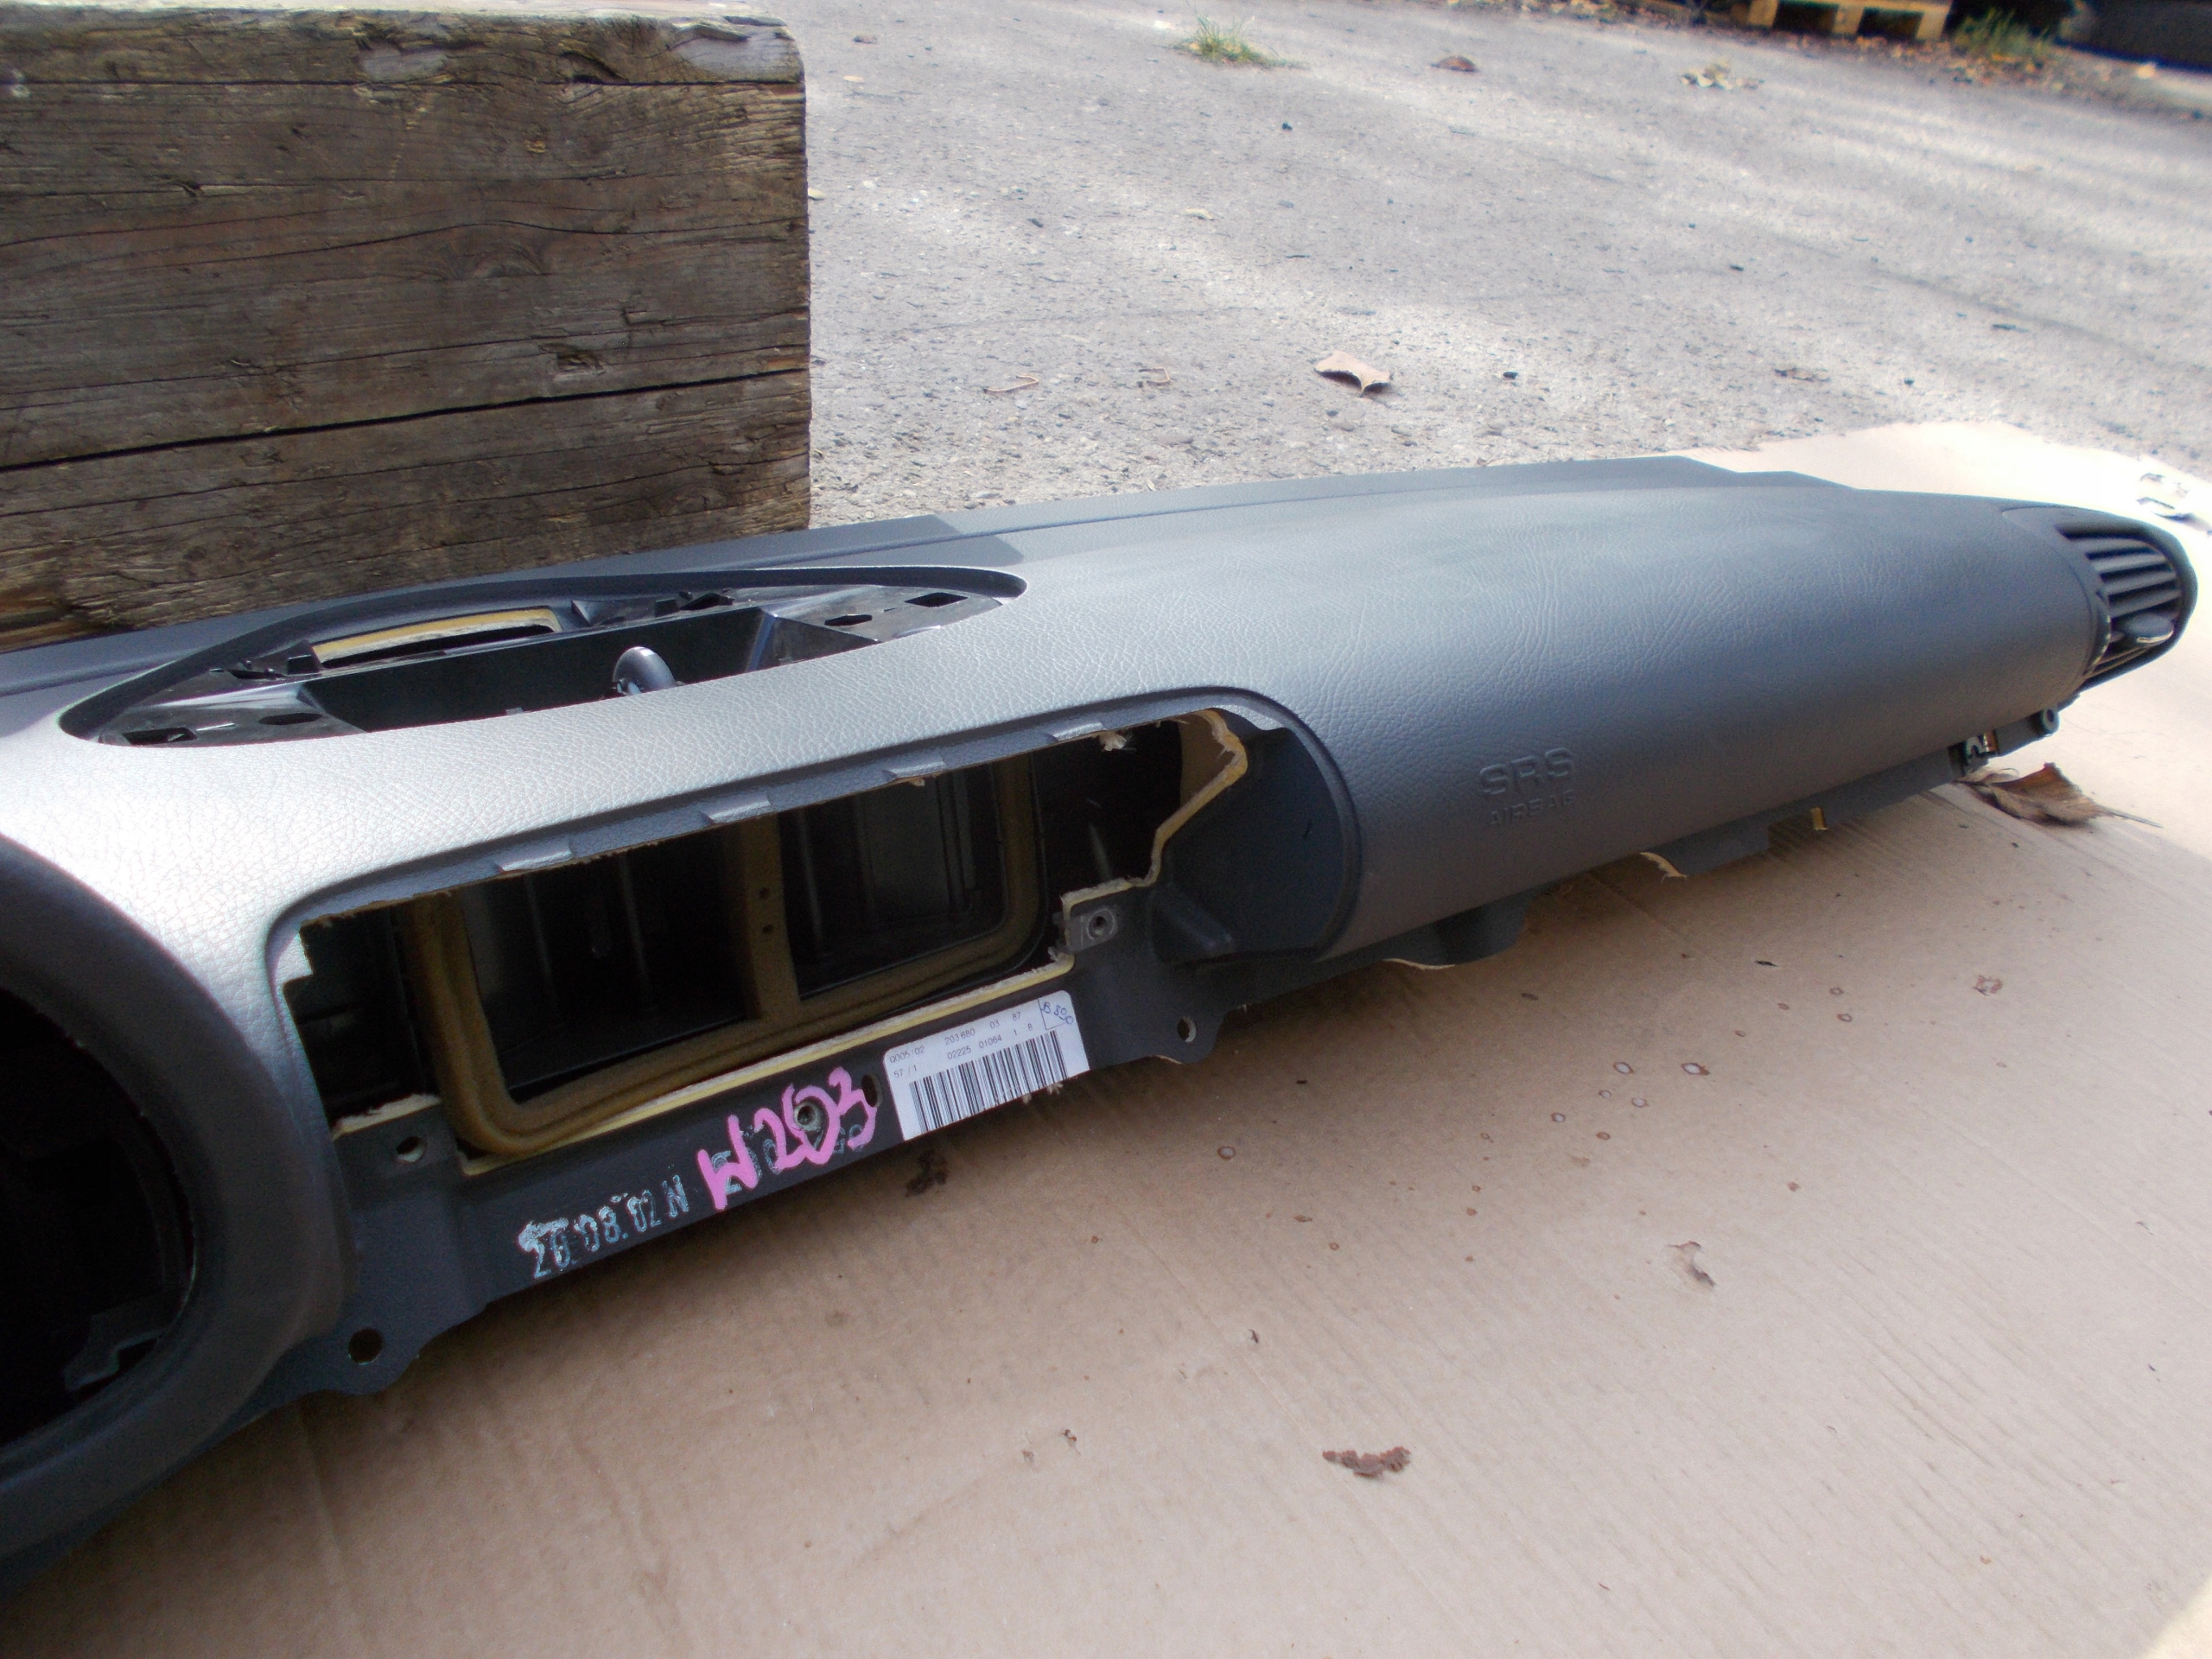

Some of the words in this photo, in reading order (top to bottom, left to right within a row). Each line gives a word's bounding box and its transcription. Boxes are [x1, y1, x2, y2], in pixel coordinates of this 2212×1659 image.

[1479, 747, 1573, 795] SRS
[989, 1020, 1000, 1028] 03
[947, 1046, 971, 1059] 02225
[978, 1034, 1002, 1050] 01064
